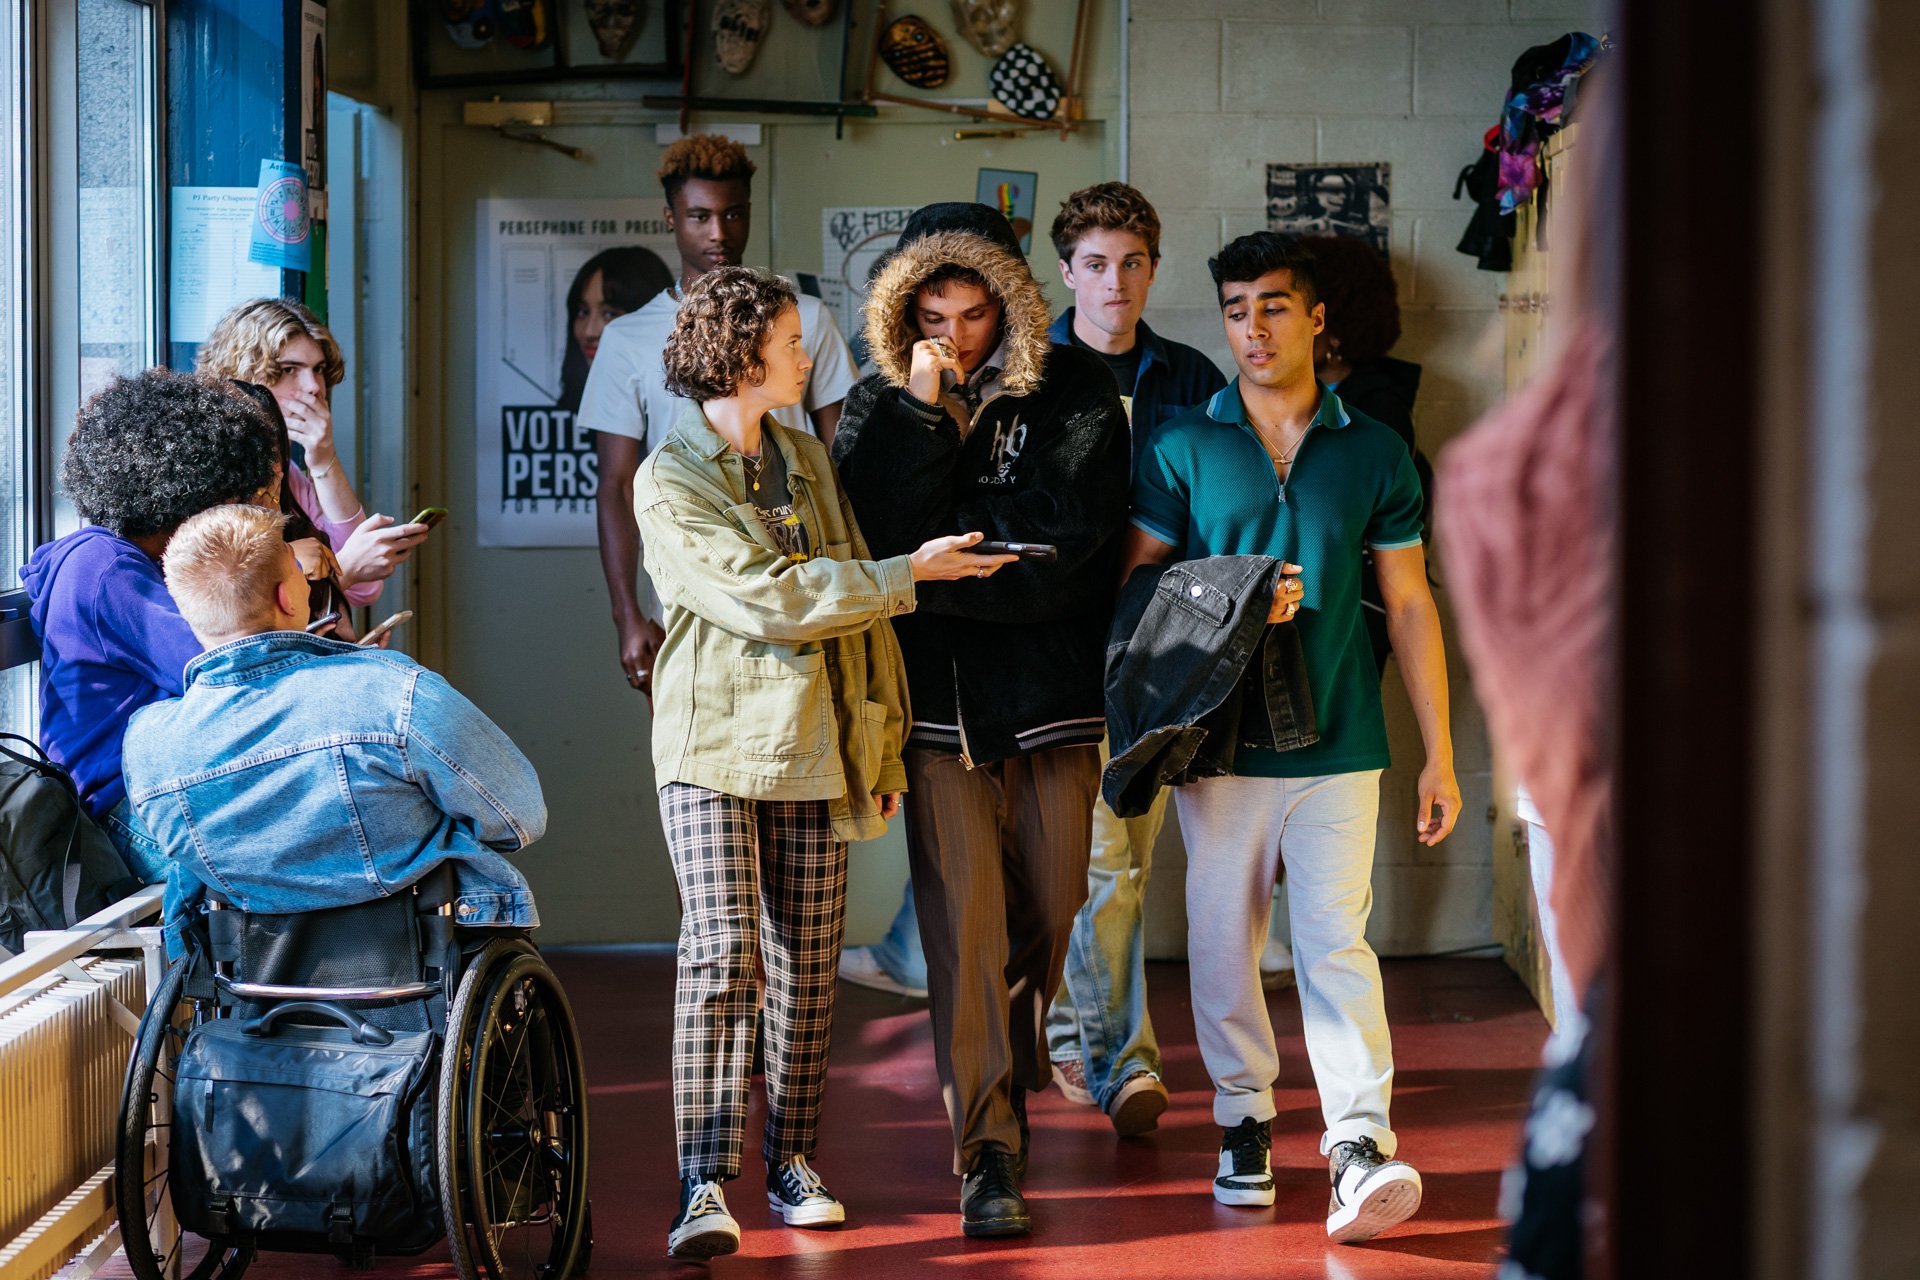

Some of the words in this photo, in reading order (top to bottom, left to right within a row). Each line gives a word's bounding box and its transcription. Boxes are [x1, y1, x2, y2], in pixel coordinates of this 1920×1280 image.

[203, 194, 220, 203] Party
[499, 220, 585, 235] PERSEPHONE
[592, 220, 617, 235] FOR
[505, 410, 592, 451] VOTE
[507, 452, 599, 497] PERS
[501, 499, 538, 514] FOR
